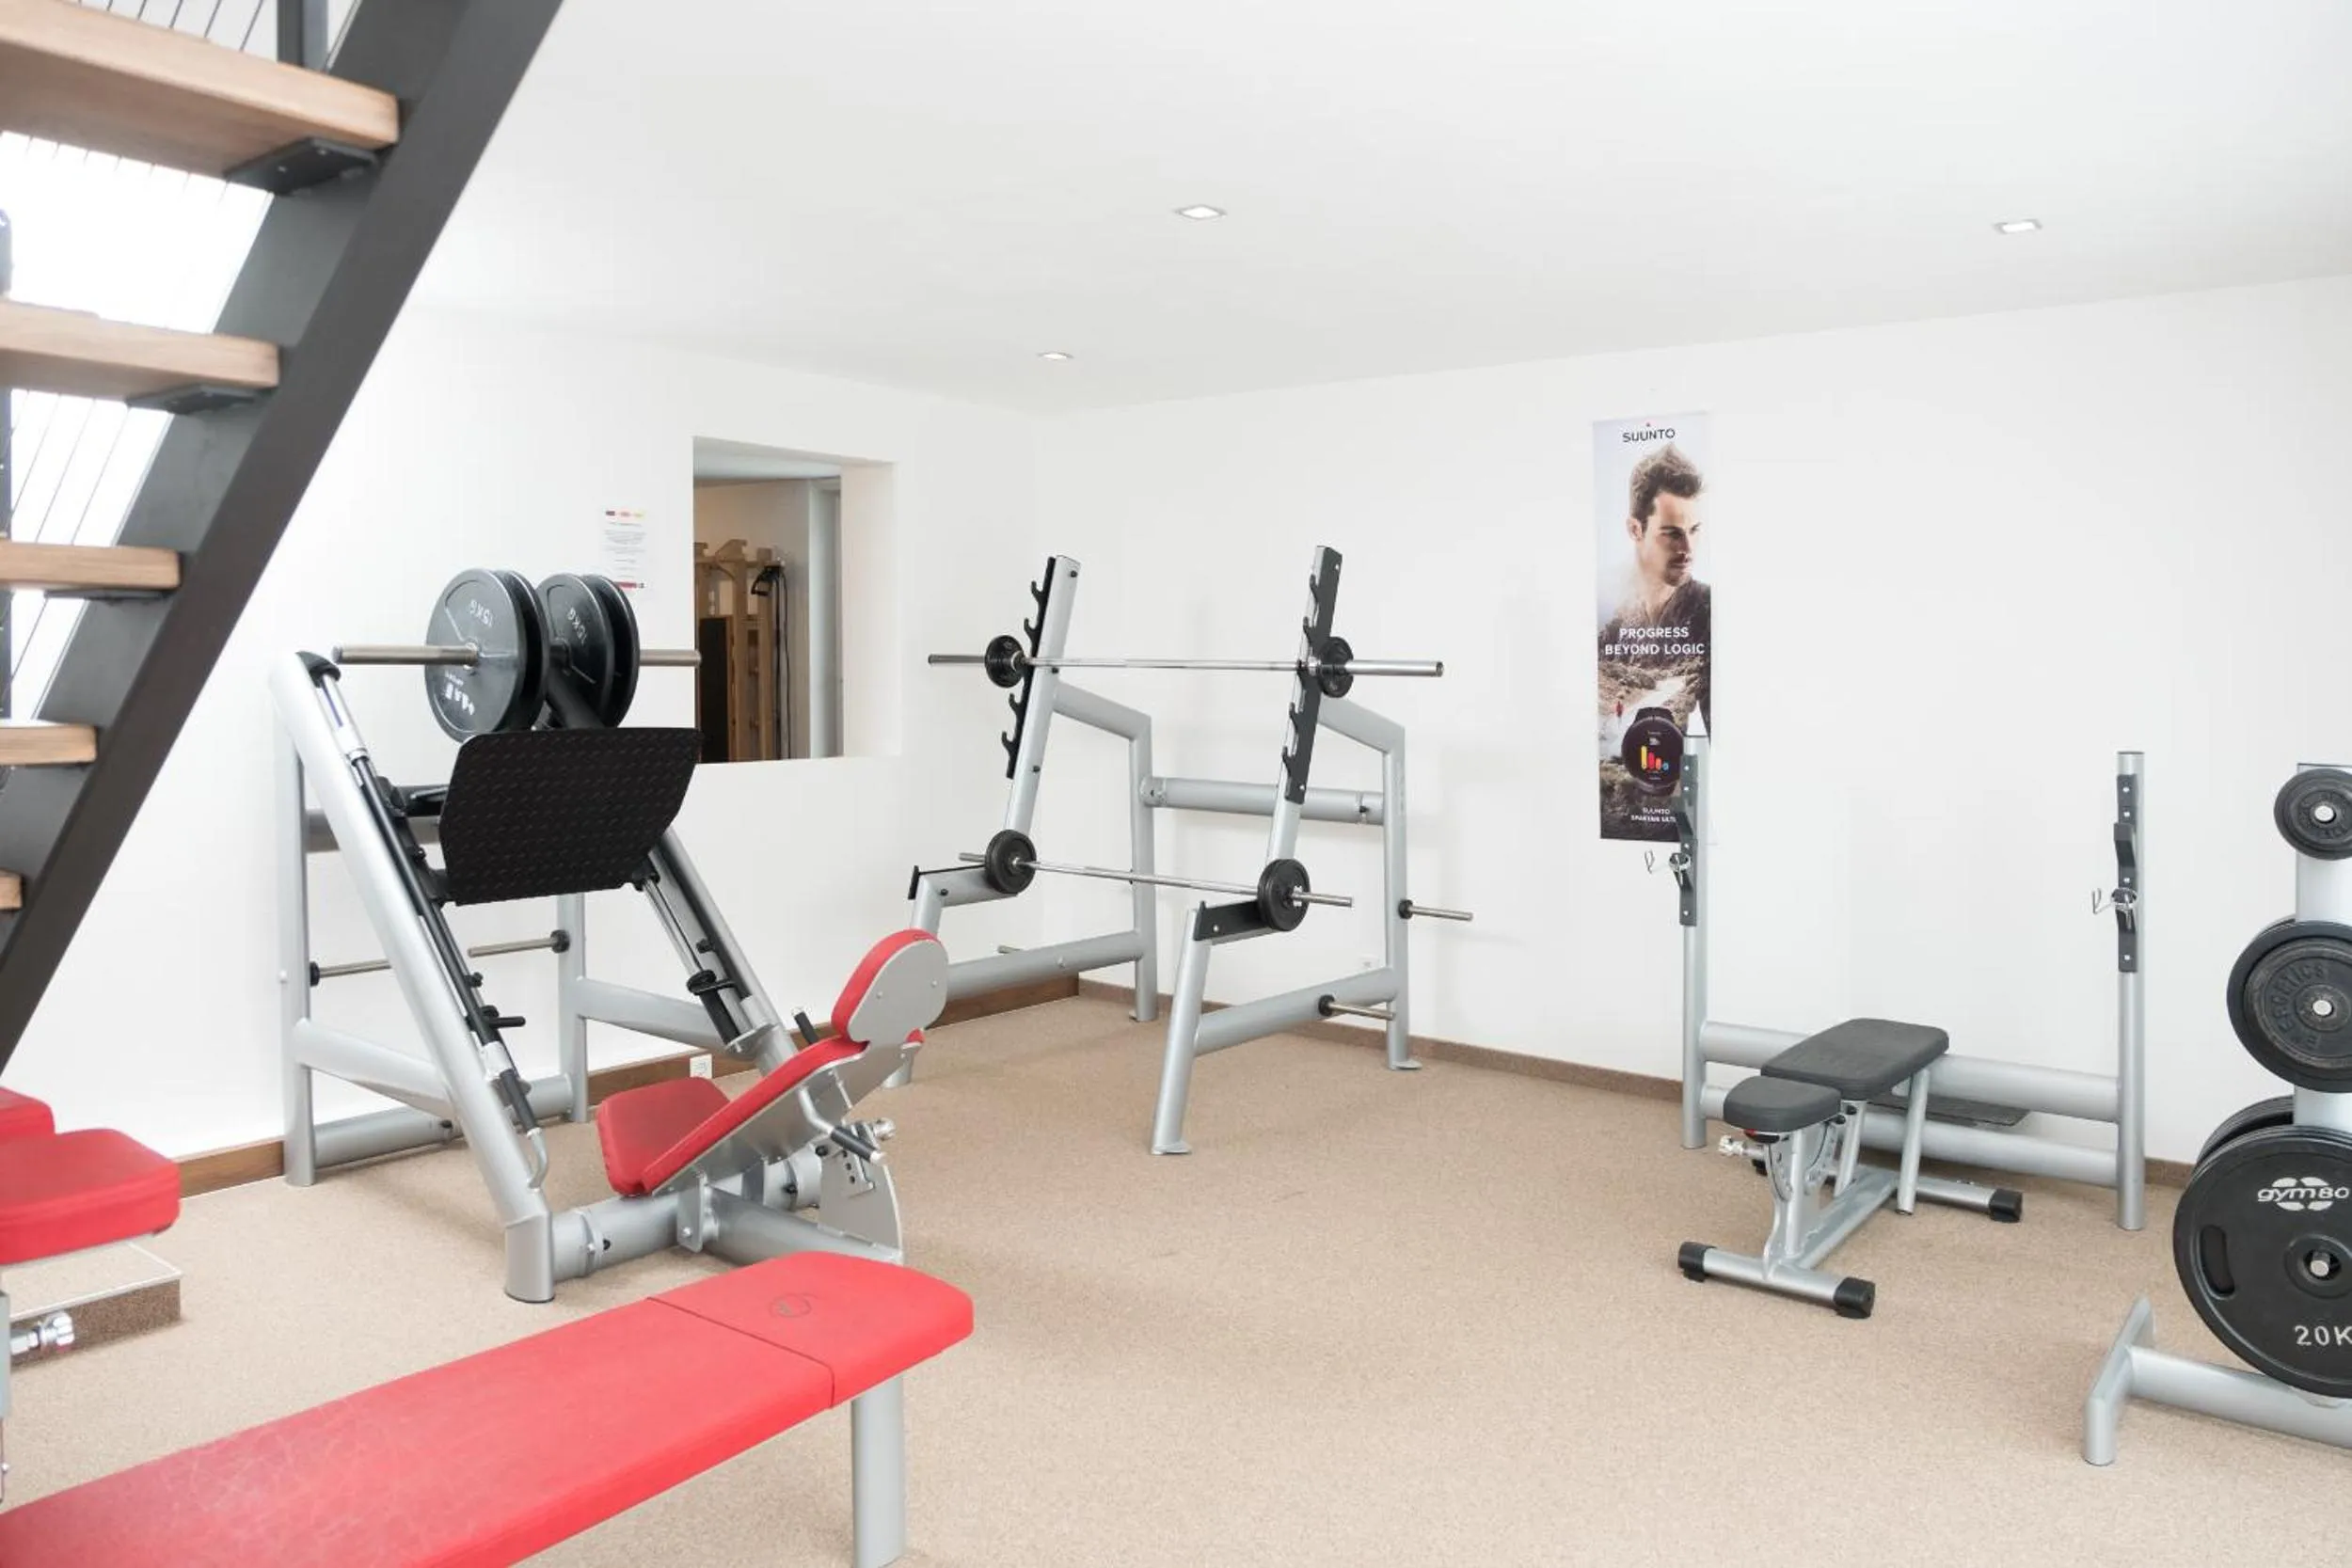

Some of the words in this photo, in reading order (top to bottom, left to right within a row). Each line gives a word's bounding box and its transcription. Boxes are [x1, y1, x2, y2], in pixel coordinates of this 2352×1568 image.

[1622, 428, 1676, 443] SUUNTO
[469, 599, 494, 627] 15KG
[1618, 626, 1690, 639] PROGRESS
[1604, 643, 1660, 656] BEYOND
[1663, 642, 1706, 655] LOGIC
[2257, 1187, 2350, 1202] gym80
